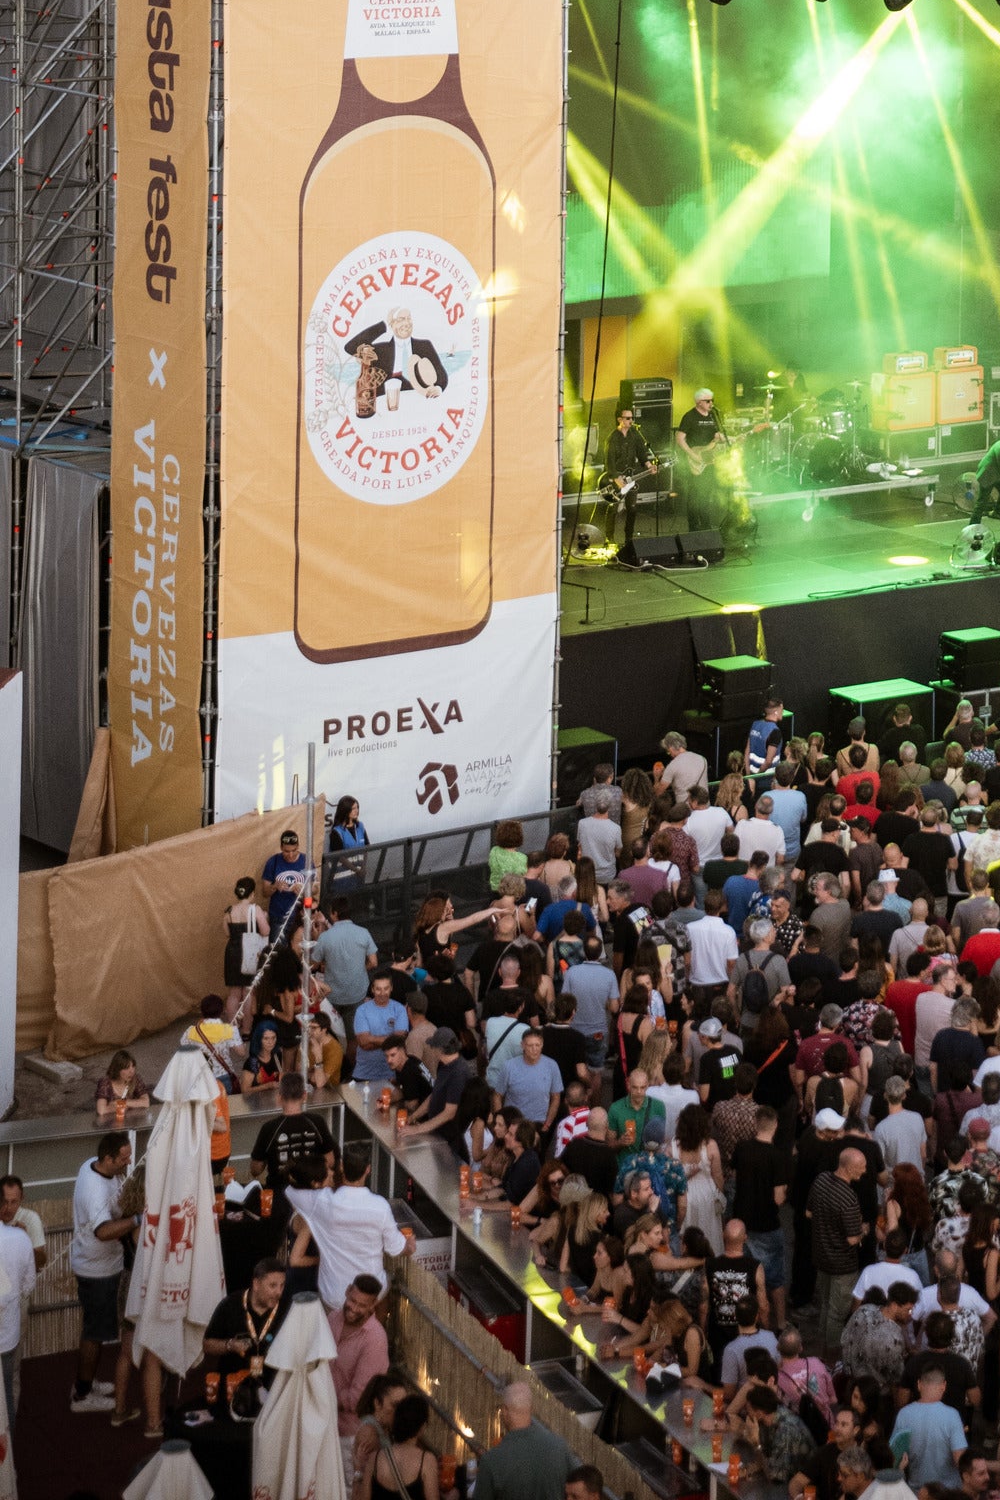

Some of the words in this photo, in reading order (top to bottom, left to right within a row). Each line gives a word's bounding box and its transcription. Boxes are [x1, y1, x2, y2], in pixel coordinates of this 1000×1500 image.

[363, 6, 442, 21] VICTORIA
[144, 154, 178, 304] fest
[323, 247, 398, 316] MALAGUEÑA
[403, 247, 412, 258] Y
[415, 247, 472, 300] EXQUISITA
[331, 263, 465, 338] CERVEZAS
[471, 317, 480, 350] 1928
[314, 334, 324, 408] CERVEZA
[471, 355, 480, 381] EN
[335, 406, 465, 474] VICTORIA
[372, 428, 405, 439] DESDE
[407, 426, 428, 436] 1928
[434, 386, 479, 475] FRANQUELO
[320, 430, 357, 482] CREADA
[396, 470, 432, 489] LUIS
[361, 476, 391, 490] POR
[131, 419, 157, 767] VICTORIA
[158, 454, 181, 753] CERVEZAS
[323, 697, 464, 744] PROEXA
[328, 747, 344, 758] live
[346, 739, 398, 757] productions
[465, 754, 512, 773] ARMILLA
